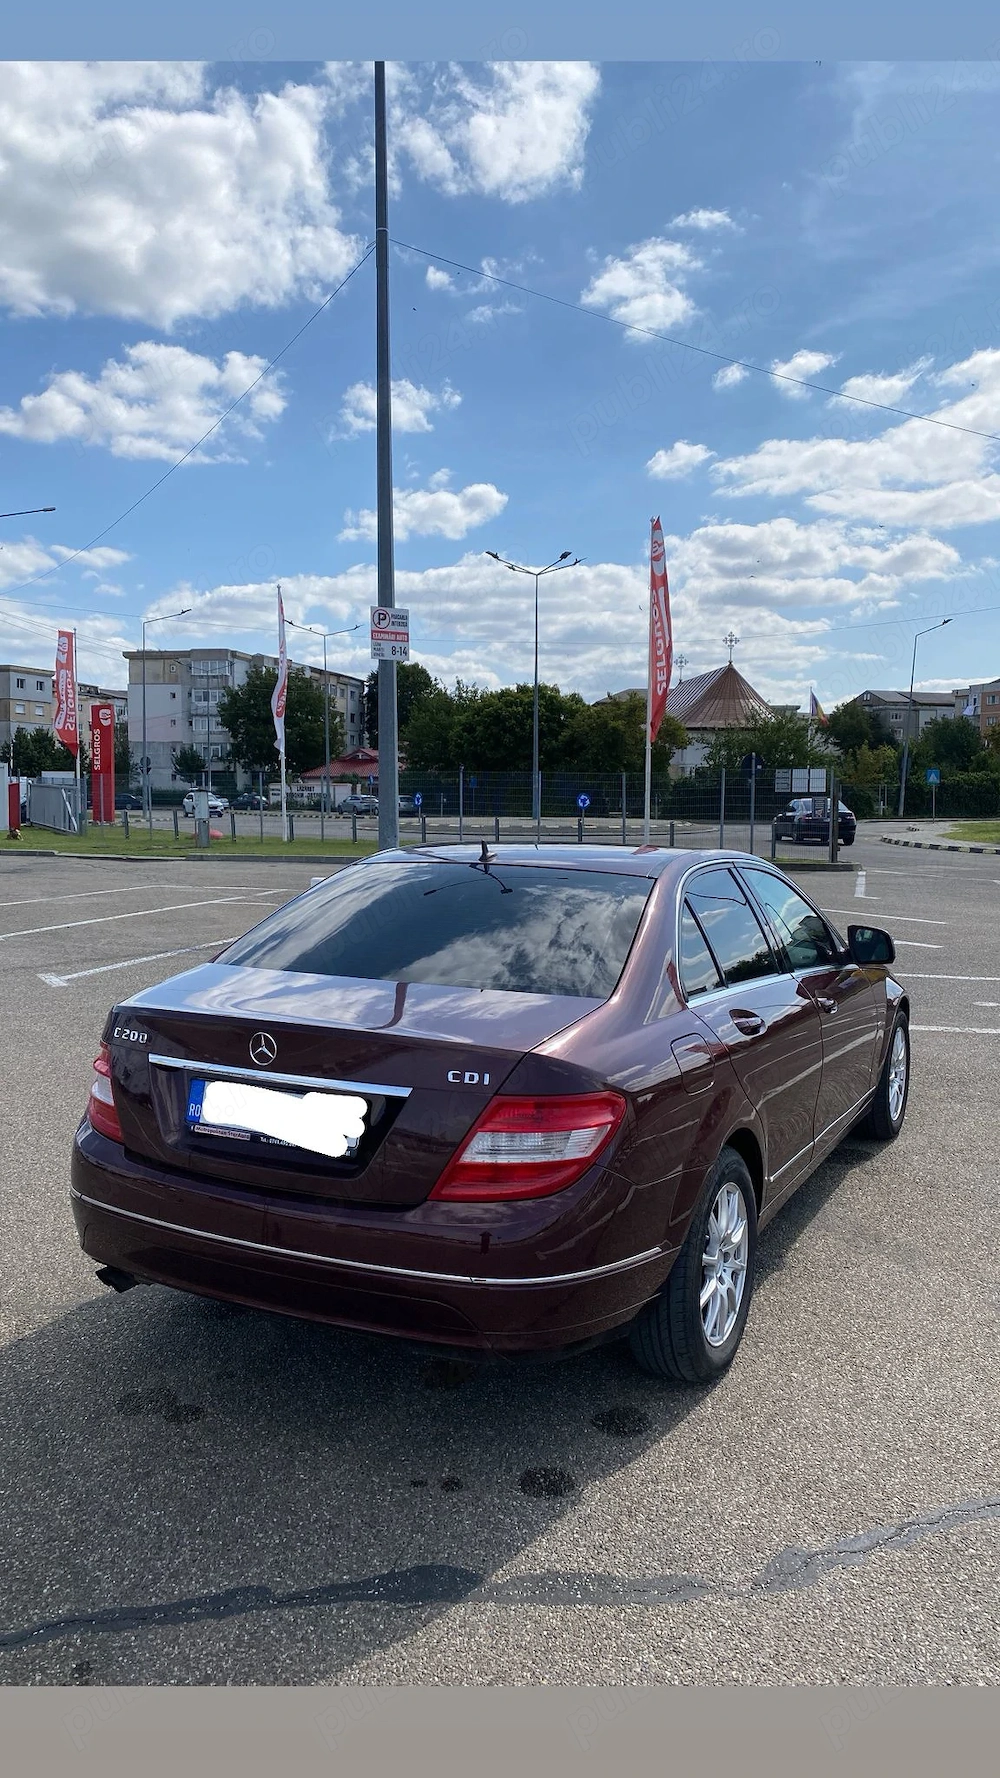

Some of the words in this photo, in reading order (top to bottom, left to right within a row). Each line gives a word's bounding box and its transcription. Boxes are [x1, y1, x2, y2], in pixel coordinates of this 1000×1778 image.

[391, 646, 408, 656] 8-14
[93, 728, 101, 771] SELGROS
[447, 1070, 490, 1086] CDI
[188, 1103, 202, 1118] RO
